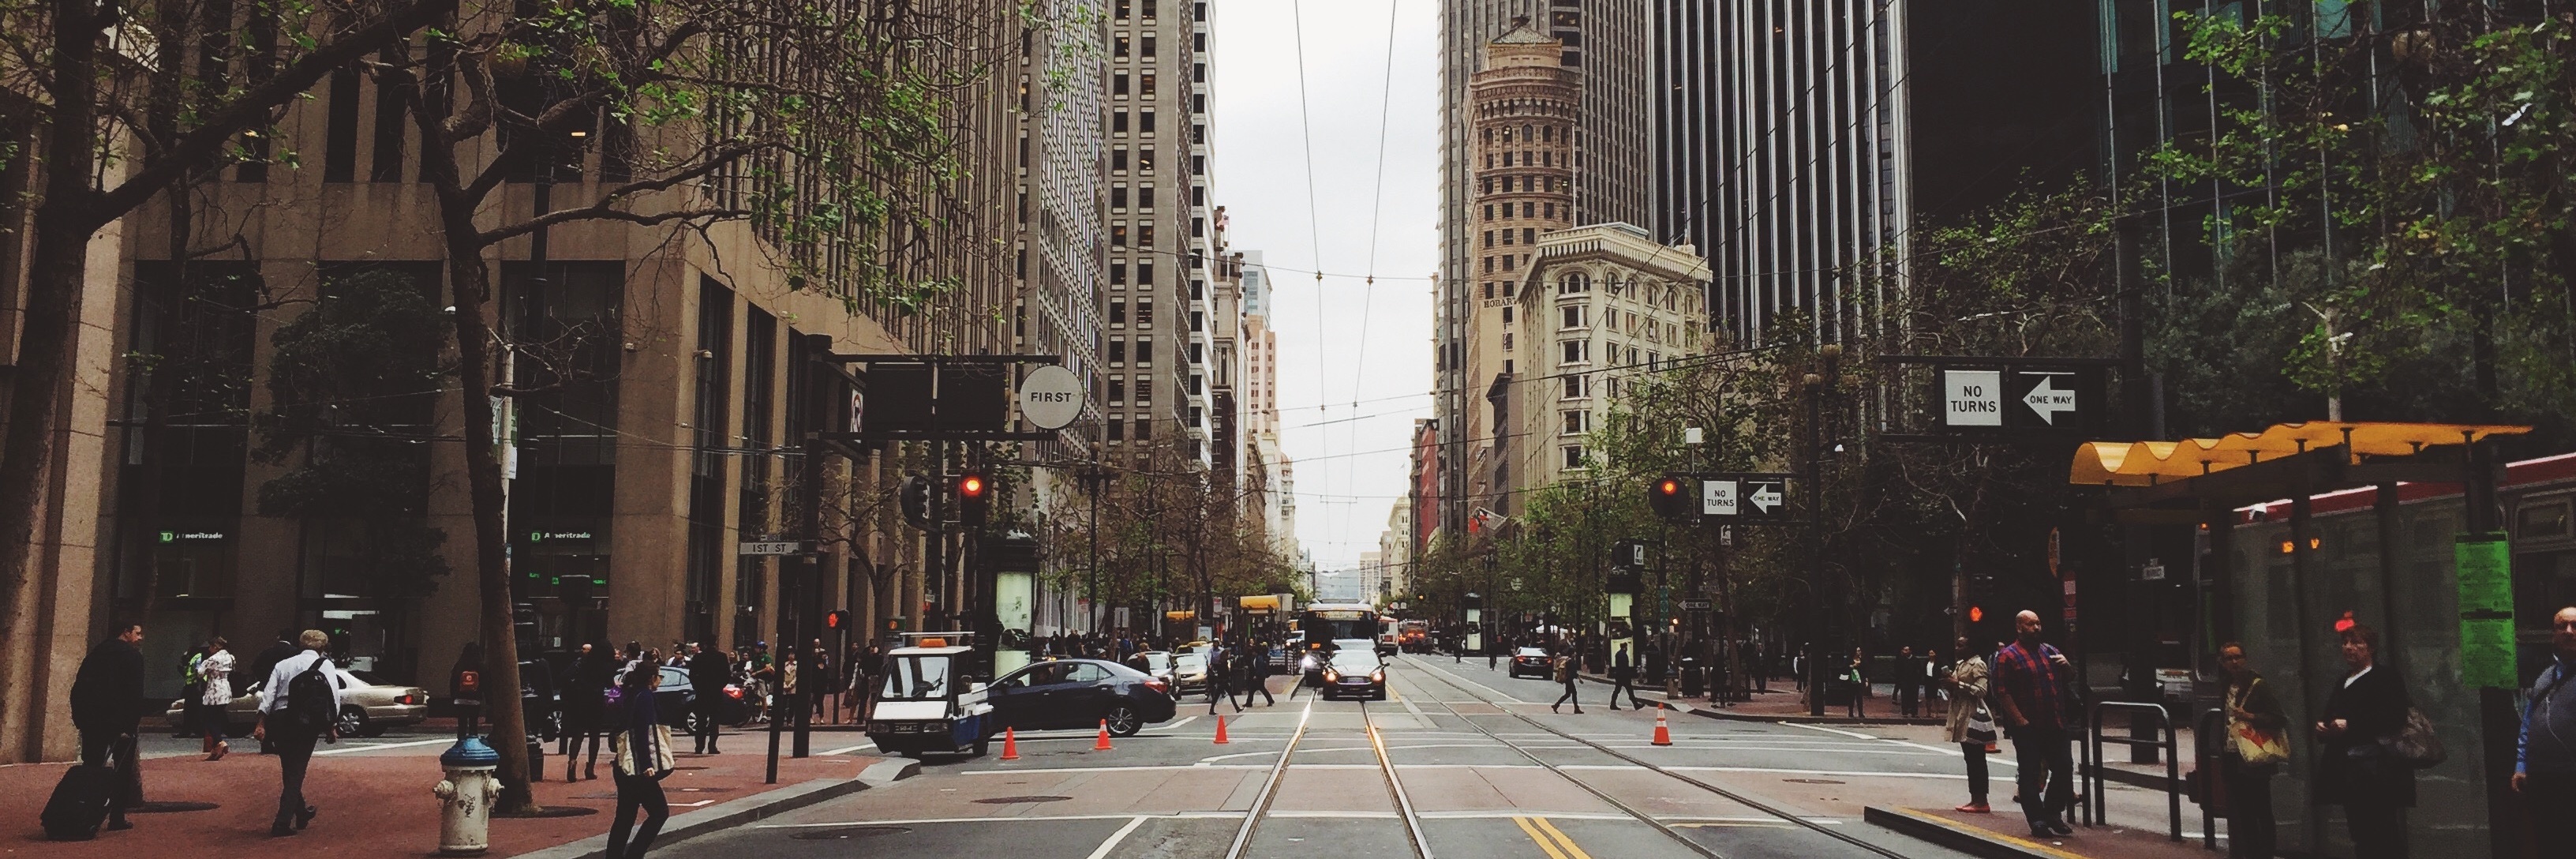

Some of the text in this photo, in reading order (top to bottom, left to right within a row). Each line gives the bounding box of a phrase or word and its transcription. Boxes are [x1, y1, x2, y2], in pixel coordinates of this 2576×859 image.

[1964, 385, 1982, 397] NO
[1031, 392, 1072, 403] FIRST
[2030, 396, 2049, 404] ONE
[1951, 401, 1997, 412] TURNS
[1707, 498, 1735, 507] TURNS
[160, 532, 173, 542] TD
[775, 543, 787, 553] ST
